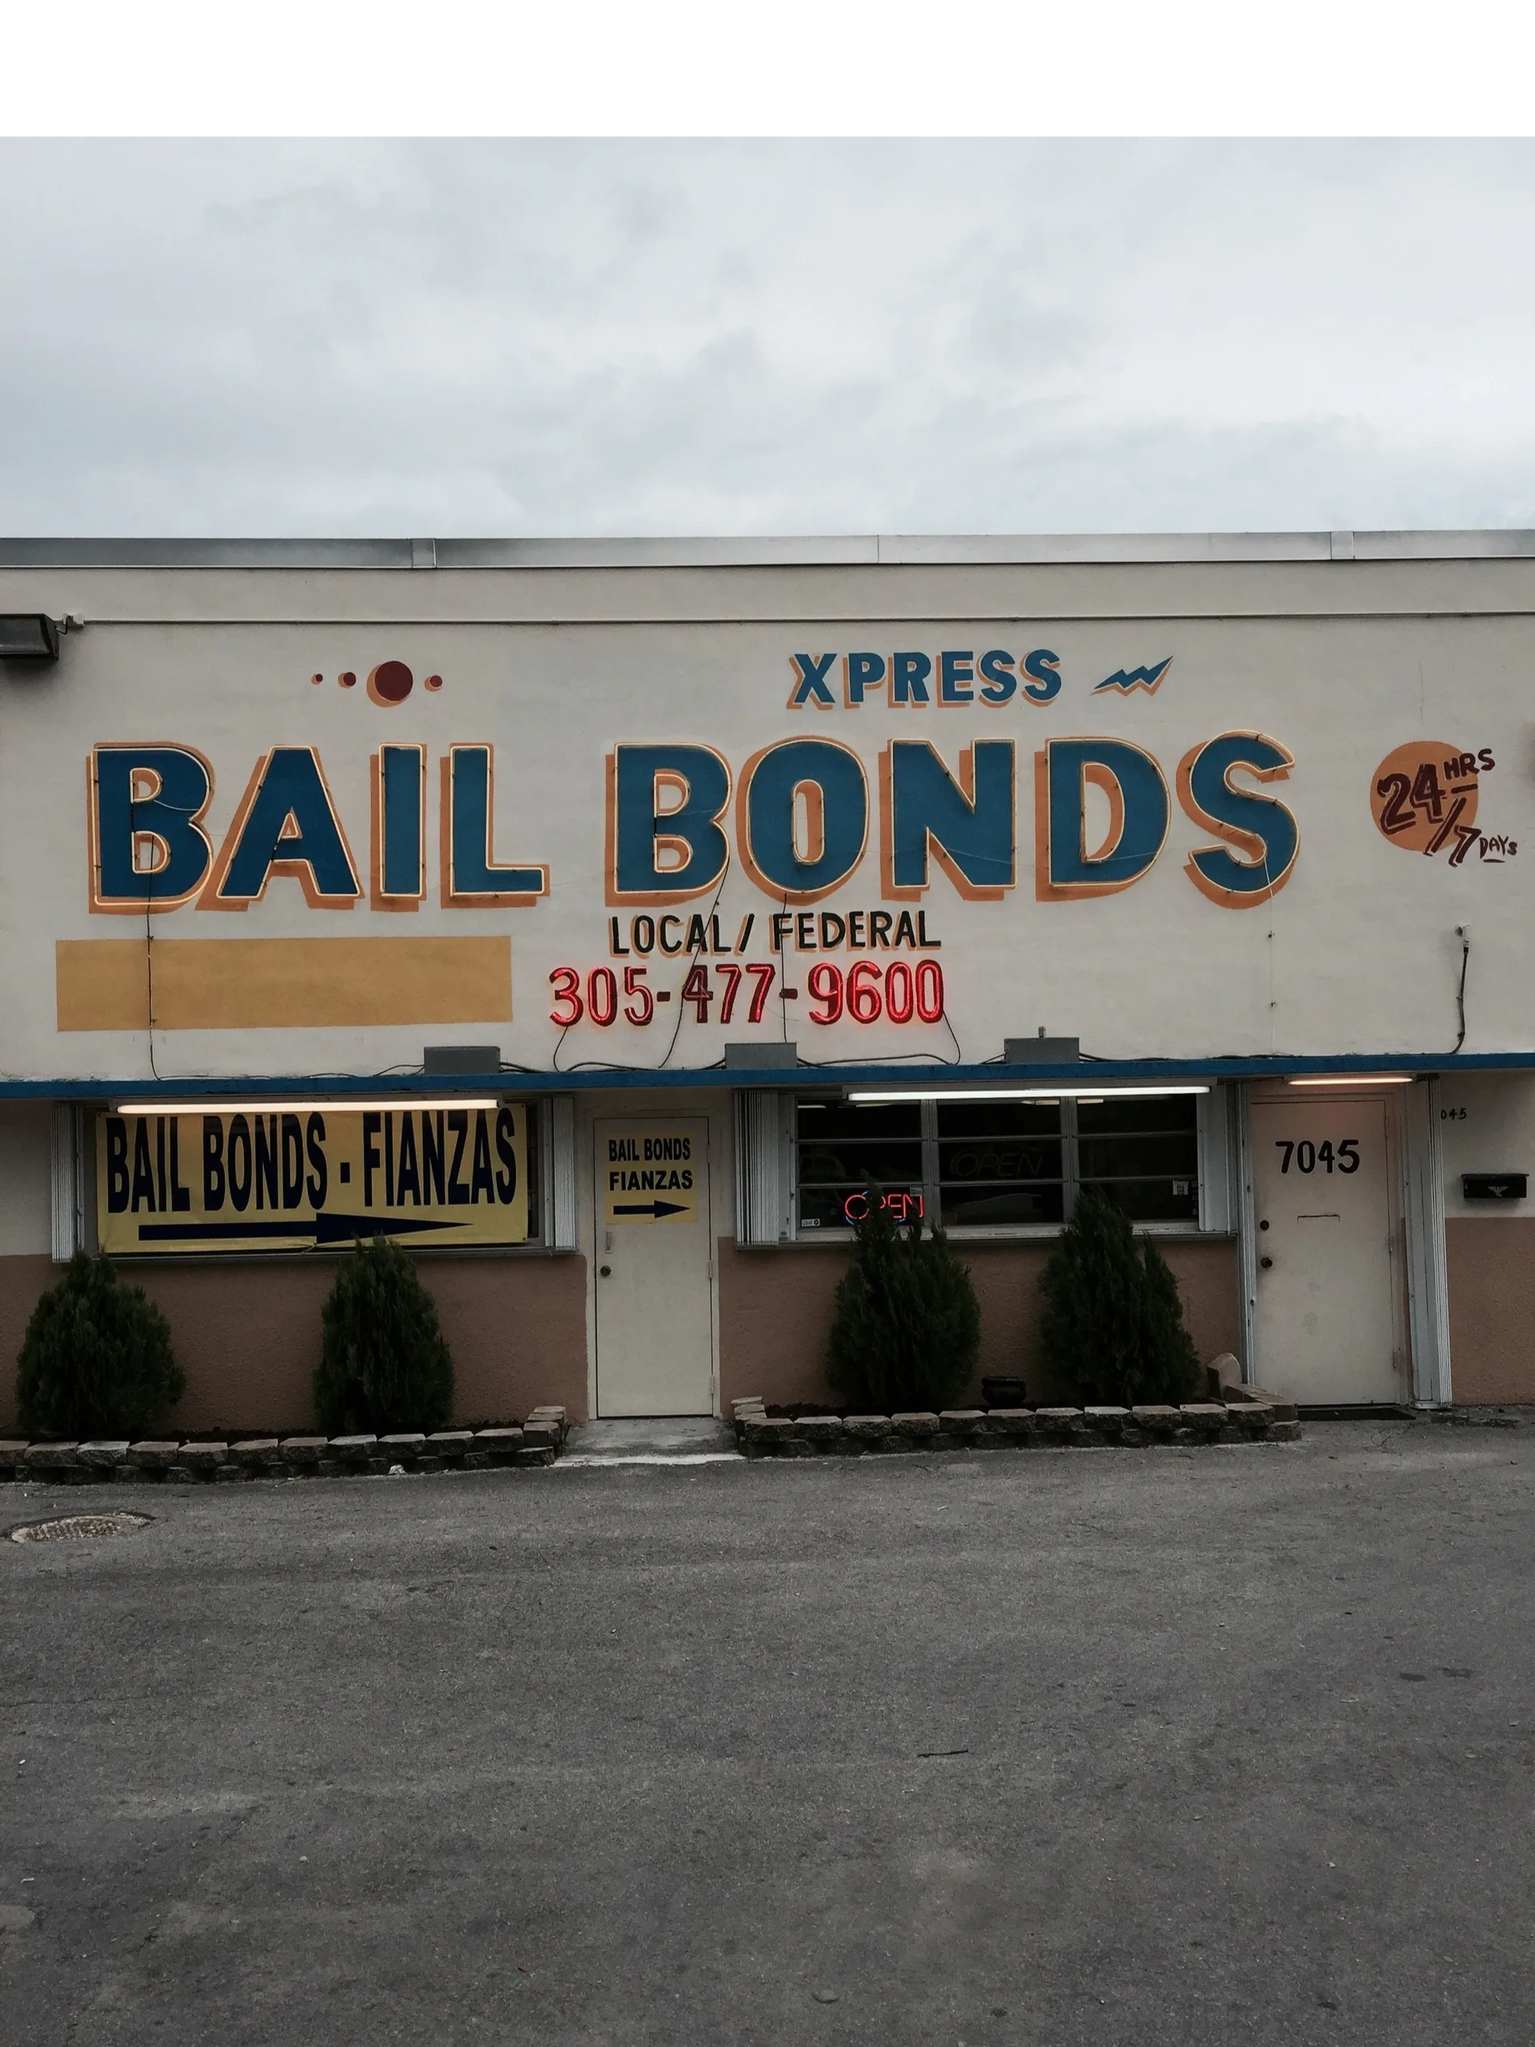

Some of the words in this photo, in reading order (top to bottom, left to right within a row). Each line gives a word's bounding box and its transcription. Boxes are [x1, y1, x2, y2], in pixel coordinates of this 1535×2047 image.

[793, 649, 1062, 703] XPRESS
[1377, 764, 1446, 835] 24
[1443, 748, 1496, 780] HRS
[90, 742, 548, 907] BAIL
[612, 730, 1301, 897] BONDS
[1479, 835, 1518, 858] DAYS
[773, 911, 942, 949] FEDERAL
[549, 959, 944, 1028] 305-477-9600
[106, 1116, 190, 1213] BAIL
[203, 1111, 328, 1210] BONDS
[363, 1107, 517, 1207] FIANZAS
[608, 1138, 640, 1162] BAIL
[643, 1137, 691, 1161] BONDS
[953, 1151, 1044, 1178] OPEN
[1275, 1139, 1361, 1174] 7045
[609, 1169, 694, 1191] FIANZAS
